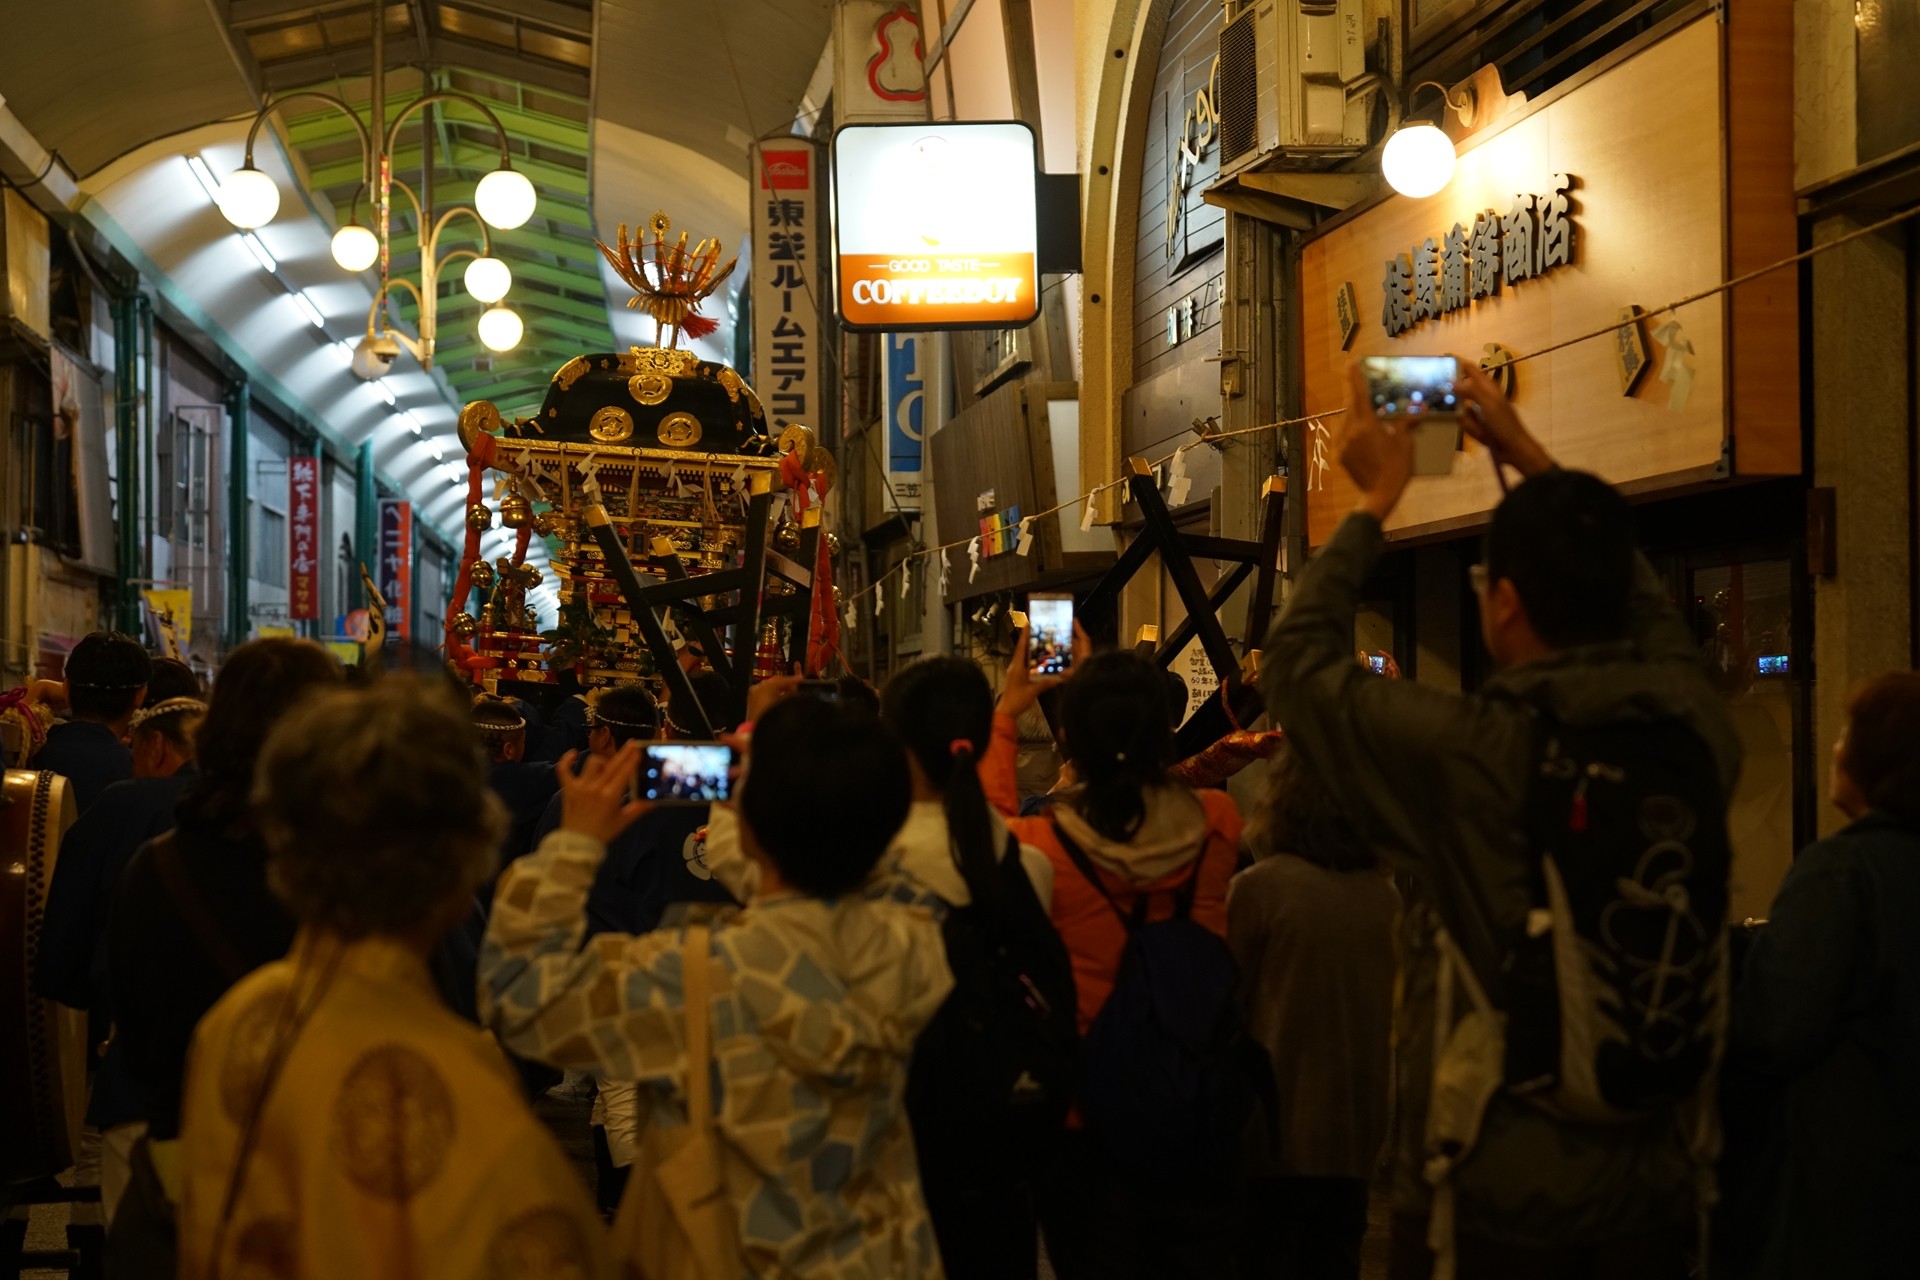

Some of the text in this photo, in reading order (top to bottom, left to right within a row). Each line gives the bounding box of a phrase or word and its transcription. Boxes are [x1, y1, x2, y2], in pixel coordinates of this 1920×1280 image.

[888, 258, 981, 273] GOOD TASTE
[1381, 173, 1573, 338] 桂馬蒲鉾商店
